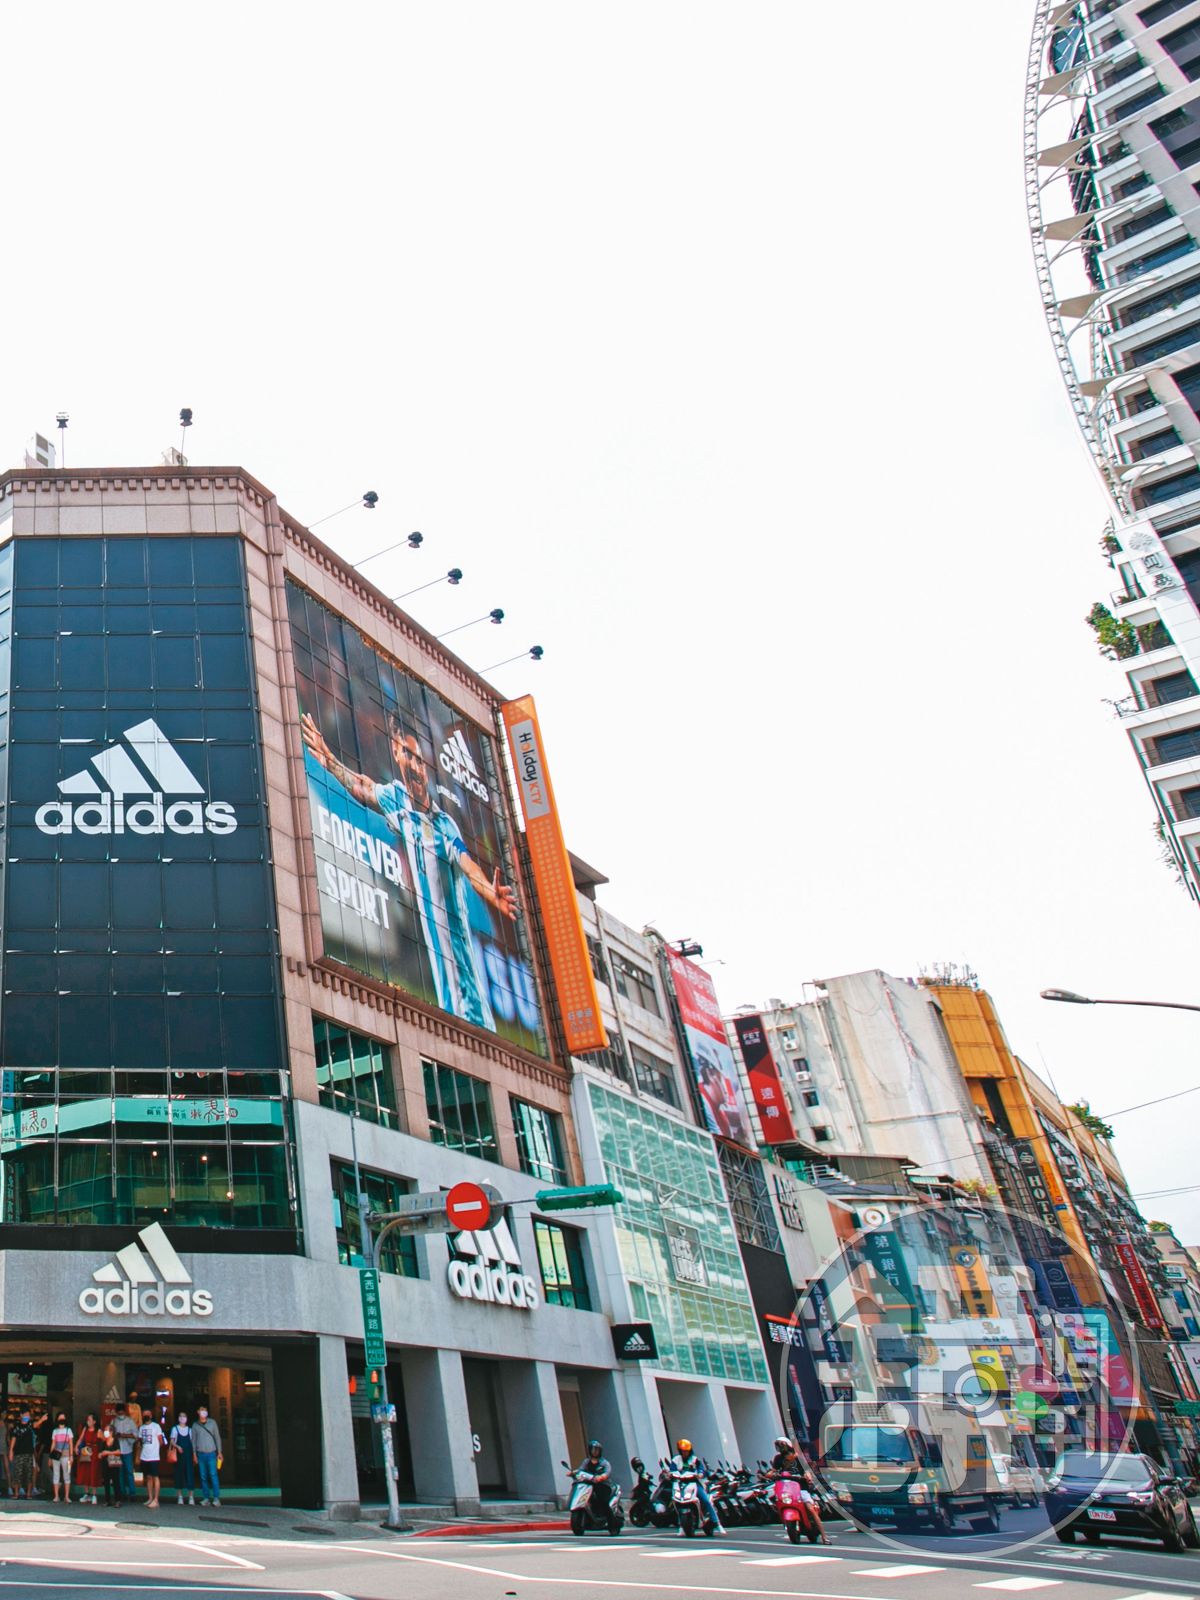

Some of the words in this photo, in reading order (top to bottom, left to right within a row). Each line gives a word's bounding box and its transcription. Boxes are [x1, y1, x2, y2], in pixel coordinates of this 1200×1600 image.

[440, 752, 490, 803] adidas
[518, 732, 539, 782] Holiday
[529, 781, 543, 805] KTV
[35, 792, 238, 836] adidas
[317, 804, 406, 891] FOREVER
[324, 863, 390, 930] SPORT
[742, 1031, 761, 1041] FET
[447, 1255, 540, 1311] adidas
[874, 1235, 900, 1286] 第一銀行
[79, 1281, 214, 1317] adidas
[364, 1280, 379, 1329] 西寧南路
[624, 1343, 651, 1352] adidas
